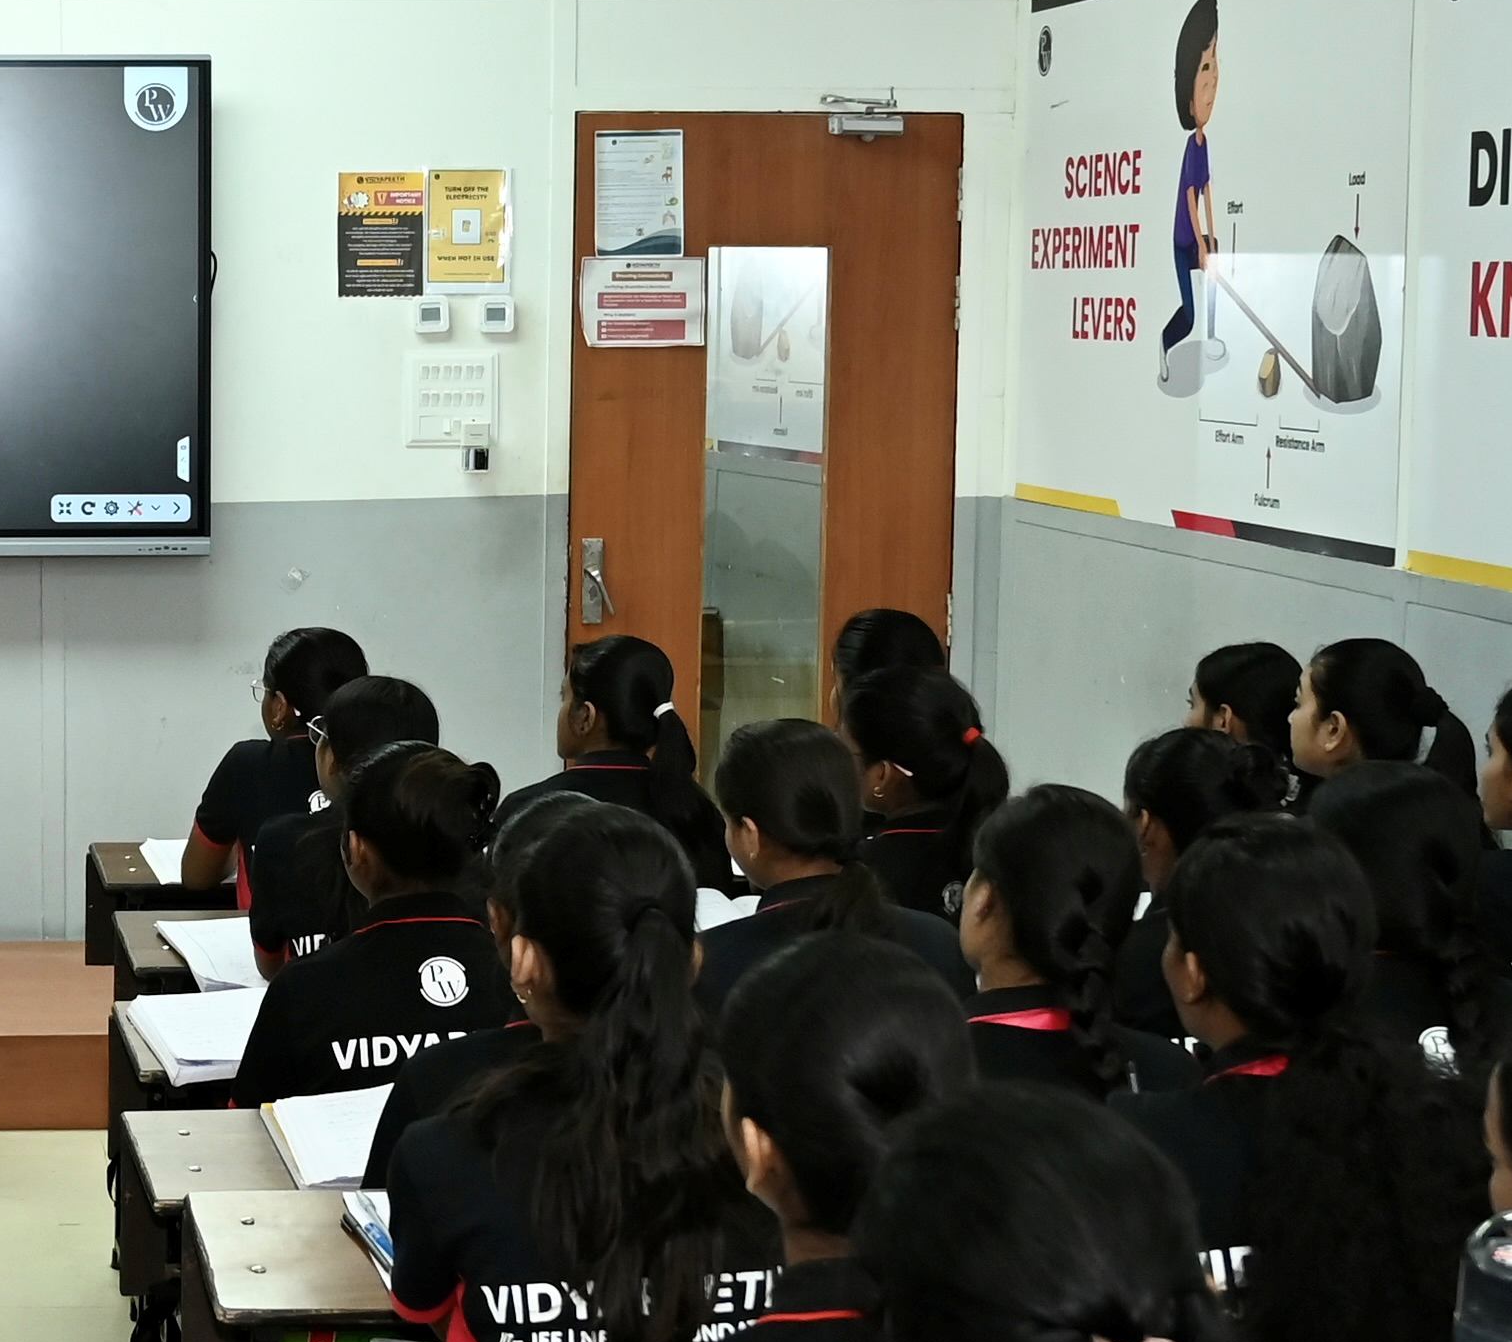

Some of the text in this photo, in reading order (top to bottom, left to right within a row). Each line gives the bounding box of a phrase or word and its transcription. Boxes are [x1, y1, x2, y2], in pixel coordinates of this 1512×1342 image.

[1064, 150, 1142, 199] SCIENCE
[1348, 171, 1365, 186] Load
[1227, 201, 1243, 214] Effort
[1031, 224, 1139, 269] EXPERIMENT
[1072, 297, 1137, 341] LEVERS
[1231, 433, 1244, 445] Arm
[1275, 434, 1325, 453] Resistance Arm
[1254, 493, 1280, 509] Fulcrum
